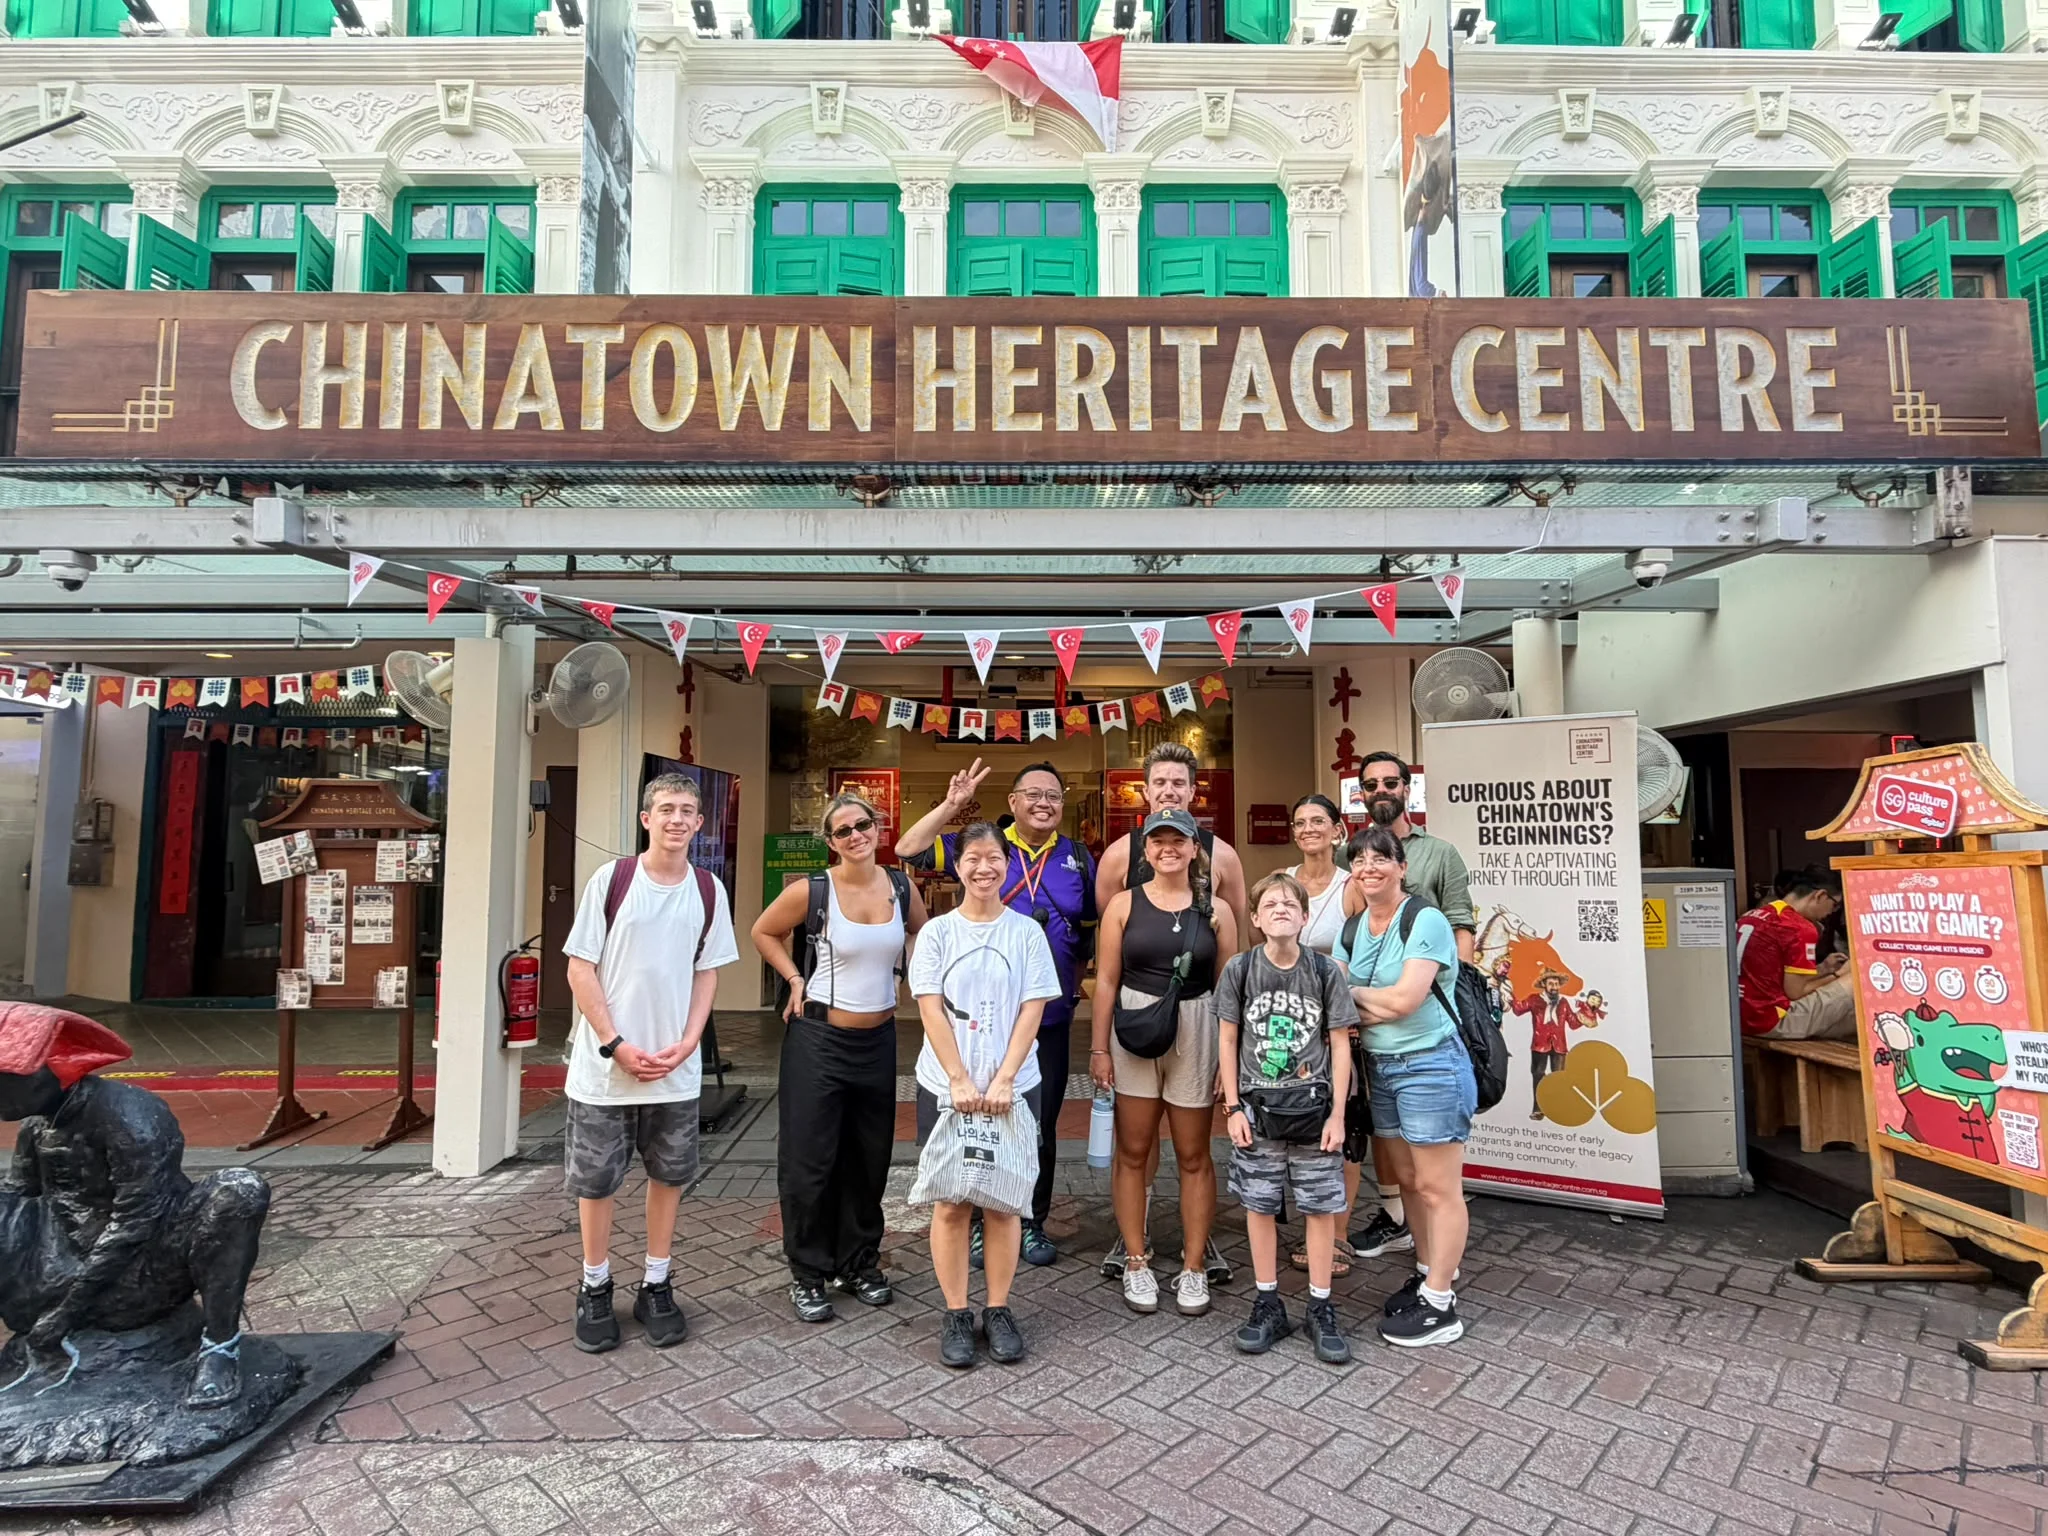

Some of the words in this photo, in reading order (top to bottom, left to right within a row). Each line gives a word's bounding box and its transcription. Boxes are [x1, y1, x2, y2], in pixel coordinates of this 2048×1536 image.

[230, 320, 872, 432] CHINATOWN
[913, 324, 1418, 432] HERITAGE
[1450, 325, 1844, 433] CENTRE
[1448, 781, 1535, 803] CURIOUS
[1542, 779, 1612, 800] ABOUT
[1885, 793, 1902, 807] SG
[1906, 802, 1933, 816] pass
[1908, 792, 1948, 809] culture
[1477, 801, 1613, 823] CHINATOWN'S
[1478, 825, 1613, 845] BEGINNINGS?
[1479, 852, 1511, 868] TAKE
[1514, 853, 1524, 868] A
[1526, 852, 1617, 868] CAPTIVATING
[1467, 870, 1508, 886] URNEY
[1511, 870, 1580, 887] THROUGH
[1584, 871, 1618, 887] TIME
[1870, 893, 1904, 911] WANT
[1907, 893, 1925, 910] TO
[1929, 893, 1964, 913] PLAY
[1970, 895, 1981, 913] A
[1860, 912, 1929, 935] MYSTERY
[1936, 912, 2003, 941] GAME?
[1879, 942, 1904, 950] COLLECT
[1905, 943, 1922, 951] YOUR
[1984, 978, 1996, 988] 90
[2015, 1070, 2029, 1082] MY
[2032, 1071, 2048, 1084] FOO
[1481, 1123, 1519, 1136] through
[1522, 1126, 1539, 1137] the
[1541, 1129, 1564, 1141] lives
[1566, 1133, 1577, 1142] of
[1579, 1135, 1605, 1147] early
[1478, 1147, 1514, 1161] thriving
[1517, 1152, 1578, 1168] community.
[1514, 1140, 1532, 1150] and
[1535, 1143, 1576, 1155] uncover
[1579, 1147, 1596, 1158] the
[1599, 1149, 1634, 1163] legacy
[963, 1161, 995, 1171] unesco
